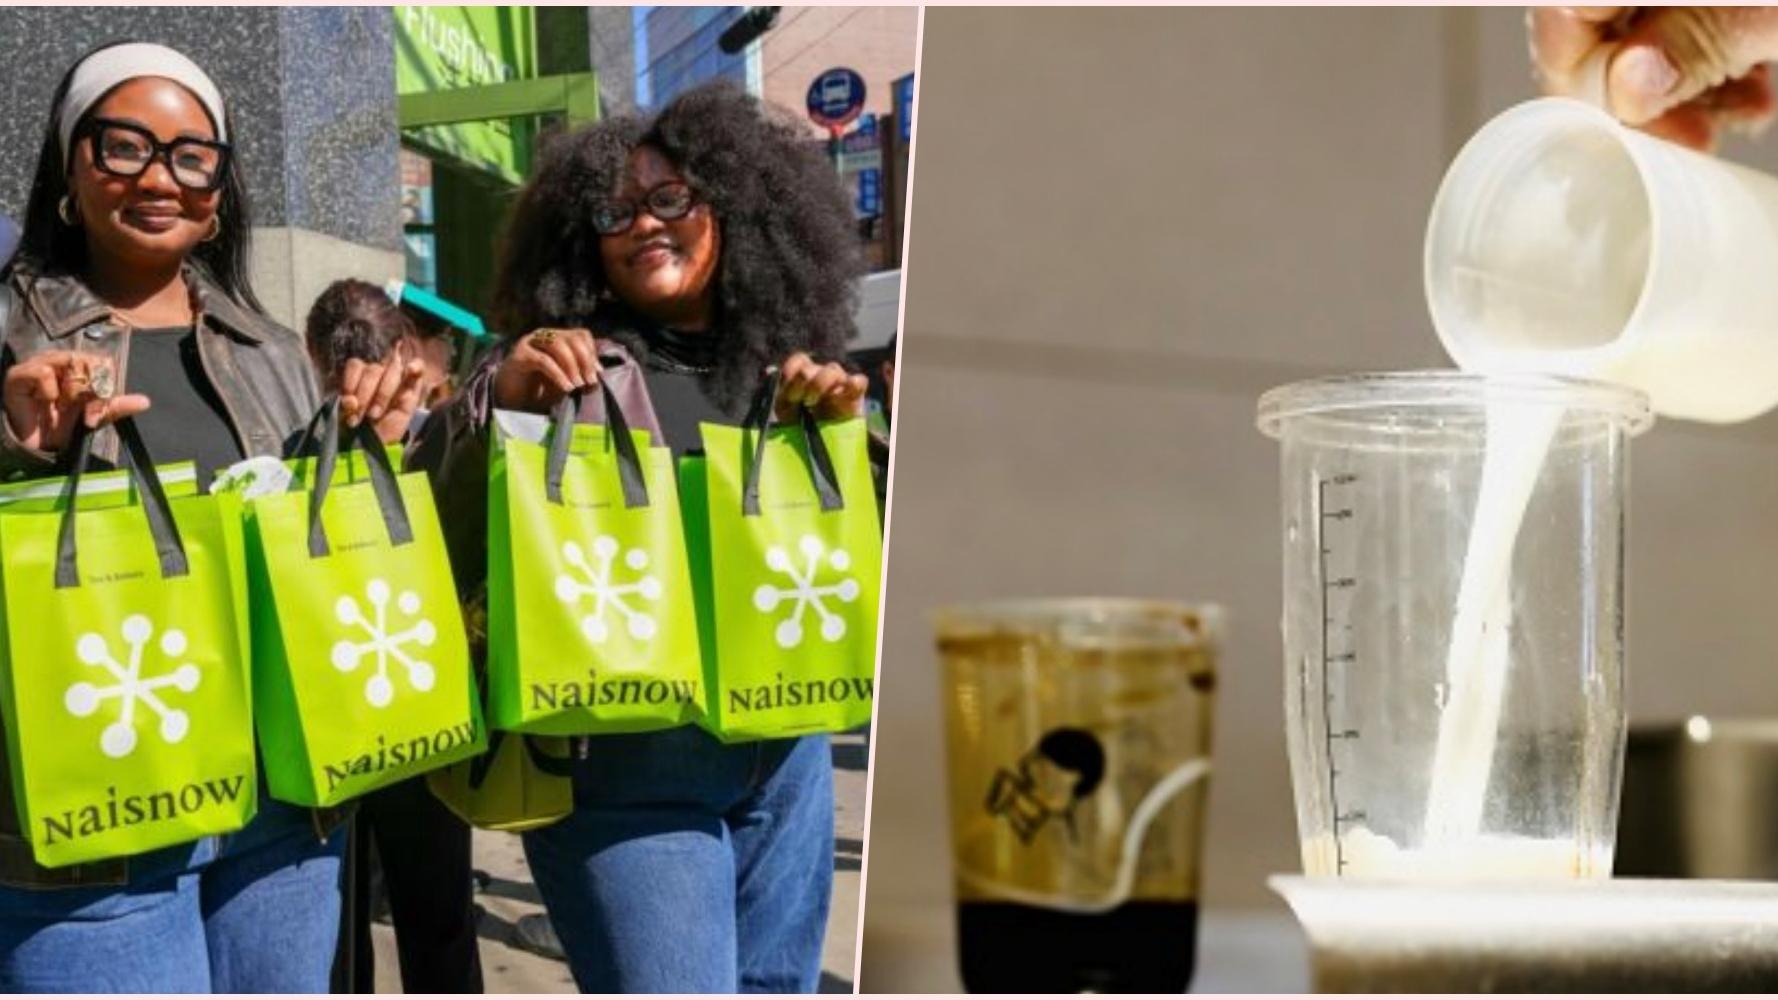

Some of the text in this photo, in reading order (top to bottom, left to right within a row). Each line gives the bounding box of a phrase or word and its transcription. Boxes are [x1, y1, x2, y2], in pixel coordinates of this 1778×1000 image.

[532, 670, 698, 711] Naisnow
[728, 673, 877, 714] Naisnow
[324, 720, 479, 793] Naisnow
[43, 774, 245, 846] Naisnow
